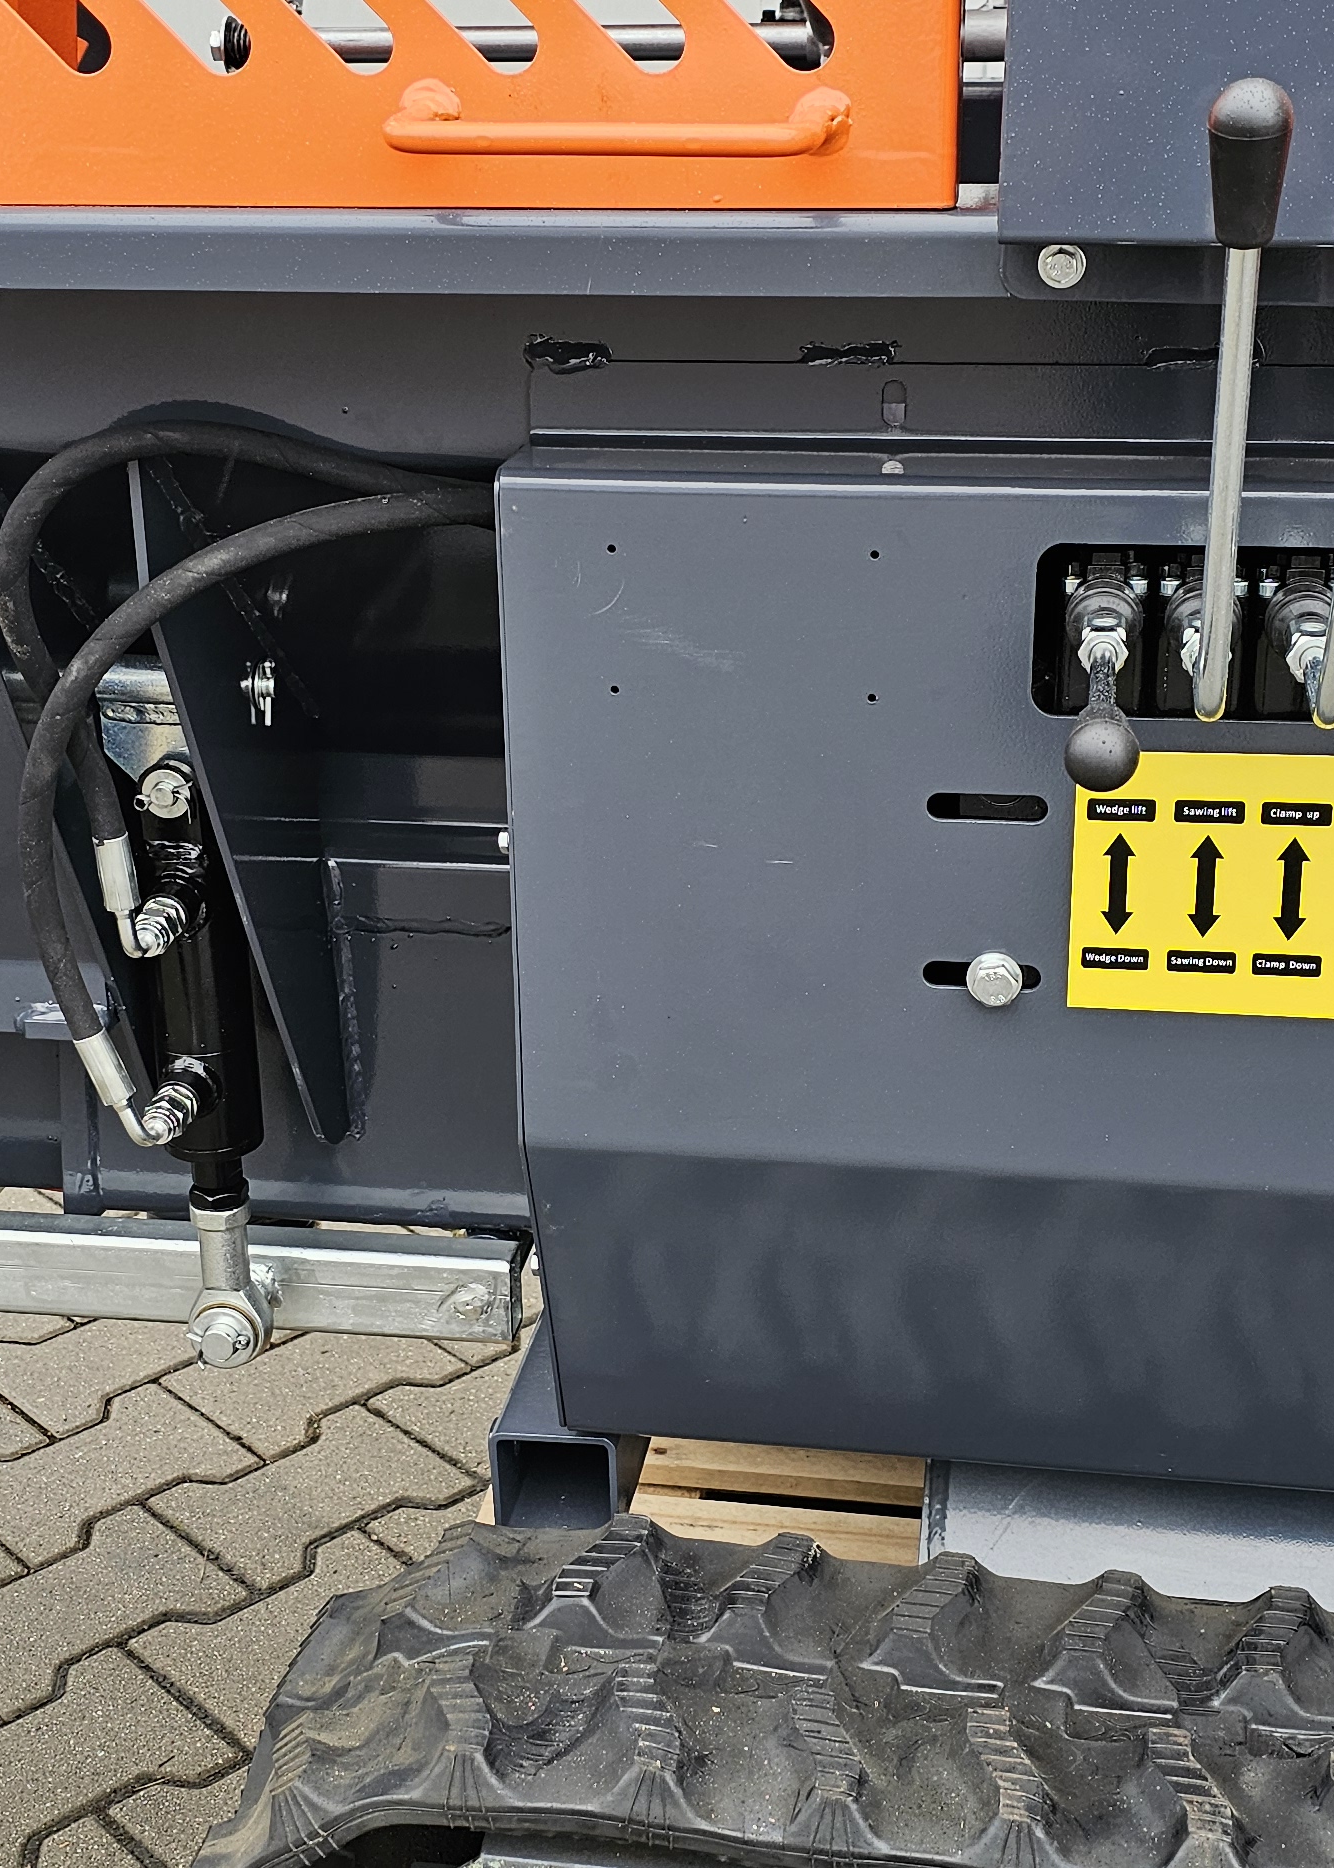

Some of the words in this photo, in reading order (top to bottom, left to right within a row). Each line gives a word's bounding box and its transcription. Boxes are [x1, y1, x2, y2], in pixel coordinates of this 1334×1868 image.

[1095, 804, 1129, 816] Wedge
[1131, 804, 1147, 815] lift
[1182, 806, 1220, 818] Sawing
[1221, 806, 1237, 817] lift
[1270, 808, 1303, 820] Clamp
[1306, 810, 1320, 821] up
[1085, 952, 1117, 963] Wedge
[1117, 954, 1144, 963] Down
[1170, 956, 1205, 967] Sawing
[1205, 957, 1233, 967] Down
[1255, 959, 1286, 971] Clamp
[1289, 960, 1317, 970] Down
